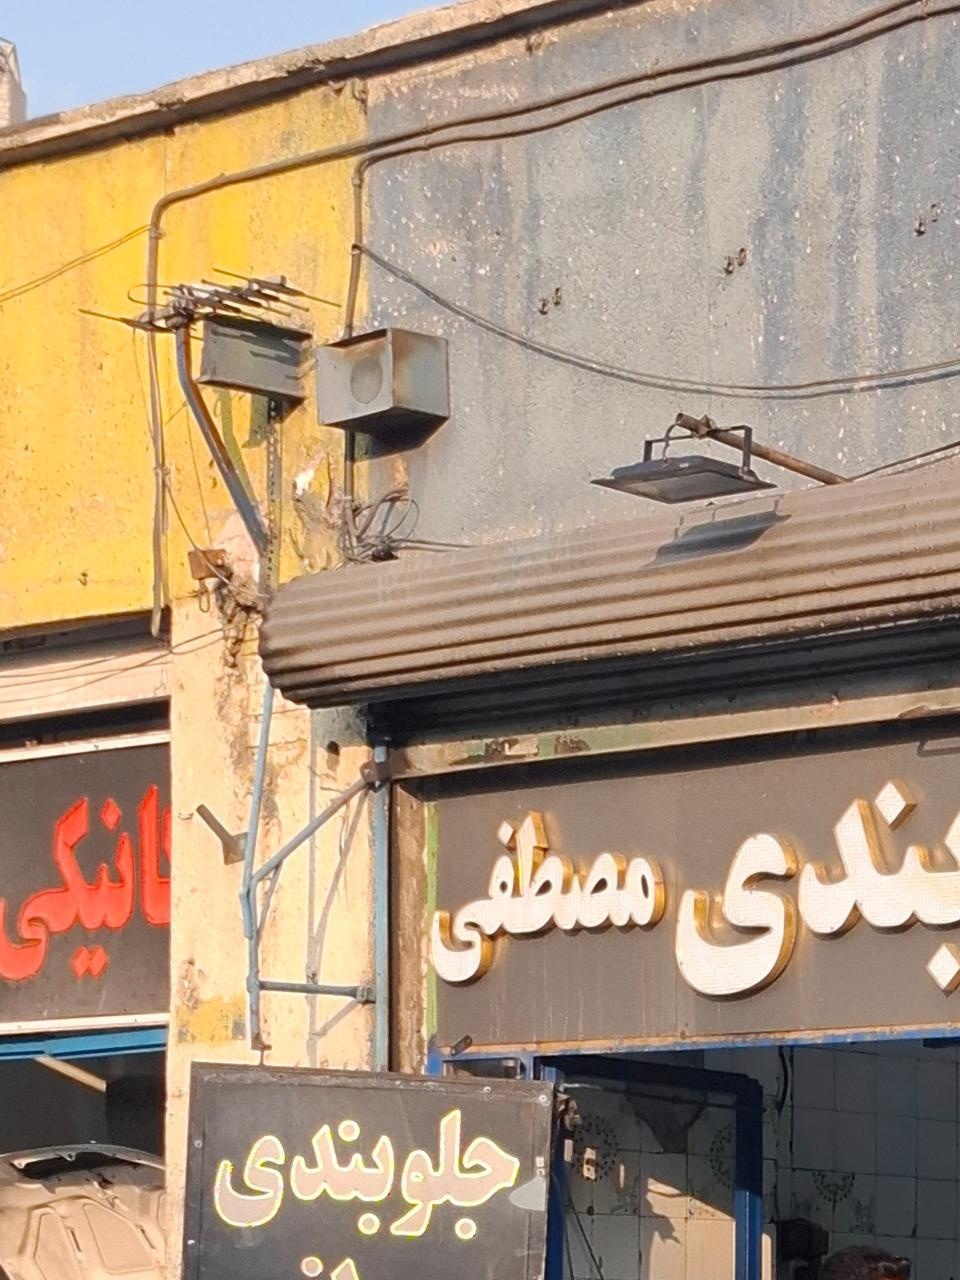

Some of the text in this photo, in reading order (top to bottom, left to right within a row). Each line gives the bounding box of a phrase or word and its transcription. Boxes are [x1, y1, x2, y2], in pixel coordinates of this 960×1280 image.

[0, 784, 171, 981] انیکی
[431, 811, 665, 985] مصطفی
[213, 1109, 521, 1240] جلوبندی
